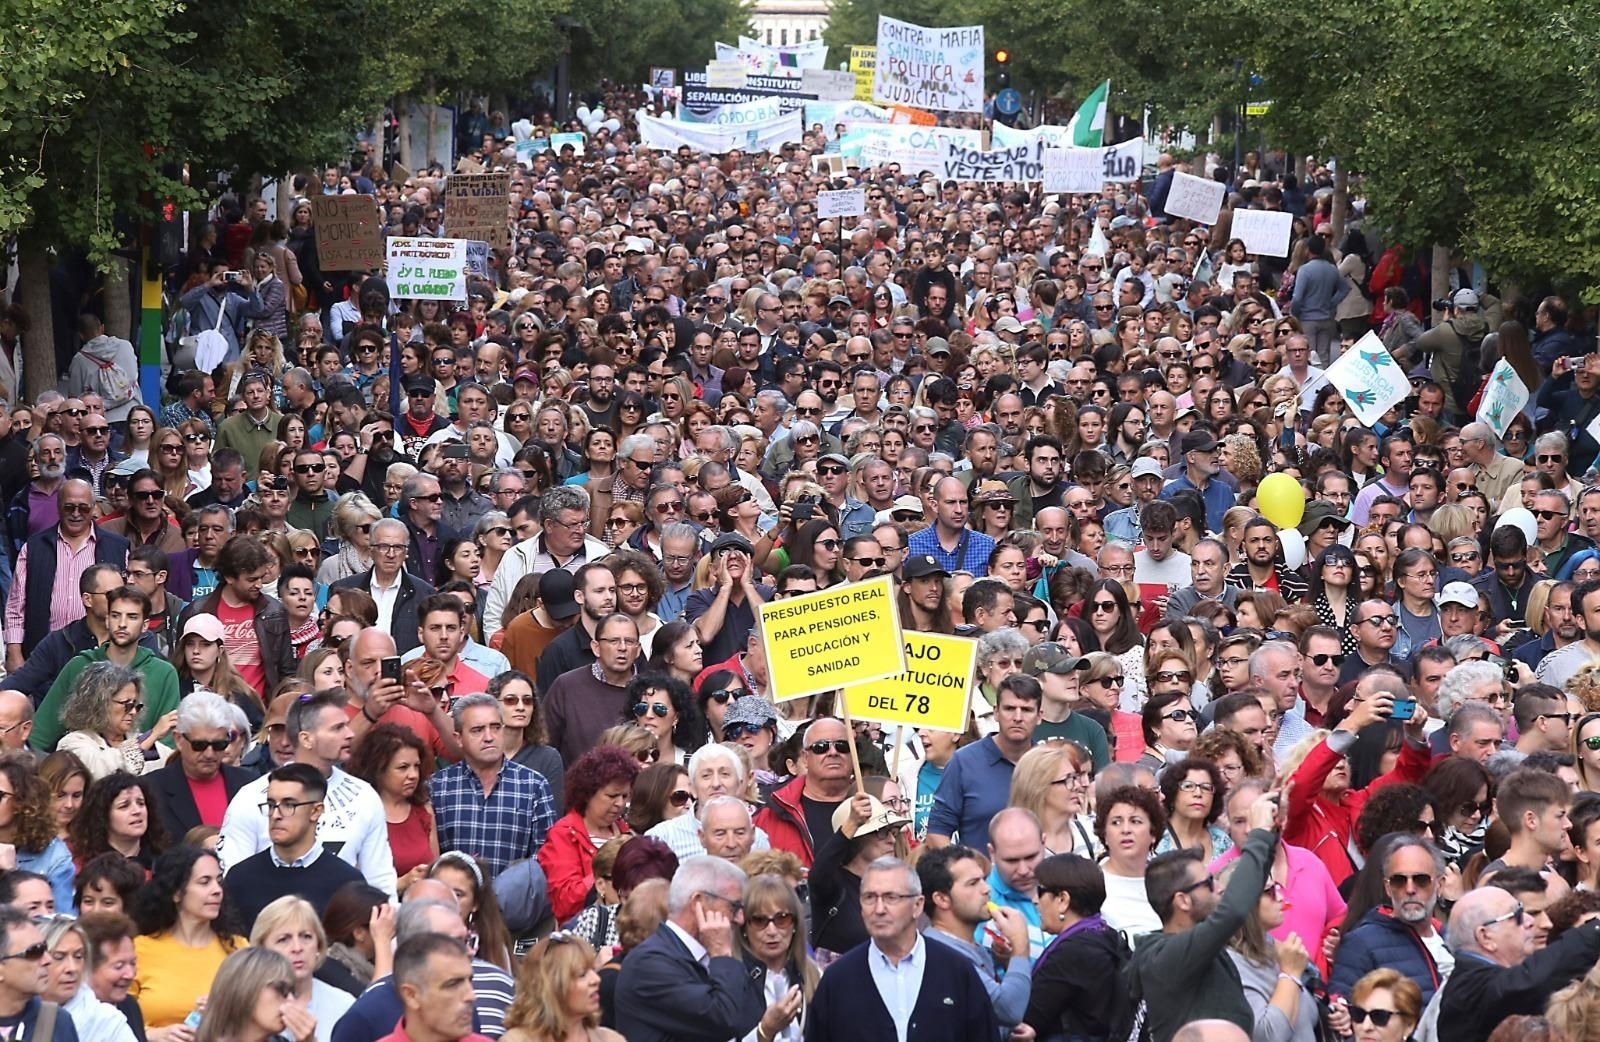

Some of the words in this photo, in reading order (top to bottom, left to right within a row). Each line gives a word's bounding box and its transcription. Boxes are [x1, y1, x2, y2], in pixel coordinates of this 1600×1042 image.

[882, 22, 924, 47] CONTRA
[940, 29, 981, 48] MAFIA
[887, 42, 945, 65] SANITARIA
[684, 72, 707, 82] LIBE
[686, 91, 750, 104] SEPARACIÓN
[884, 84, 950, 109] JUDICIAL
[949, 143, 1028, 165] MORENO
[945, 161, 1002, 180] VETE
[1003, 163, 1014, 180] A
[316, 199, 338, 217] NO
[318, 223, 359, 241] MORIR
[397, 263, 412, 278] ¿Y
[415, 267, 425, 278] EL
[762, 594, 850, 623] PRESUPUESTO
[853, 588, 885, 602] REAL
[774, 625, 807, 641] PARA
[809, 609, 880, 634] PENSIONES,
[790, 634, 860, 659] EDUCACIÓN
[863, 632, 870, 642] Y
[905, 642, 941, 661] AJO
[807, 656, 860, 677] SANIDAD
[868, 695, 898, 711] DEL
[905, 693, 930, 714] 78
